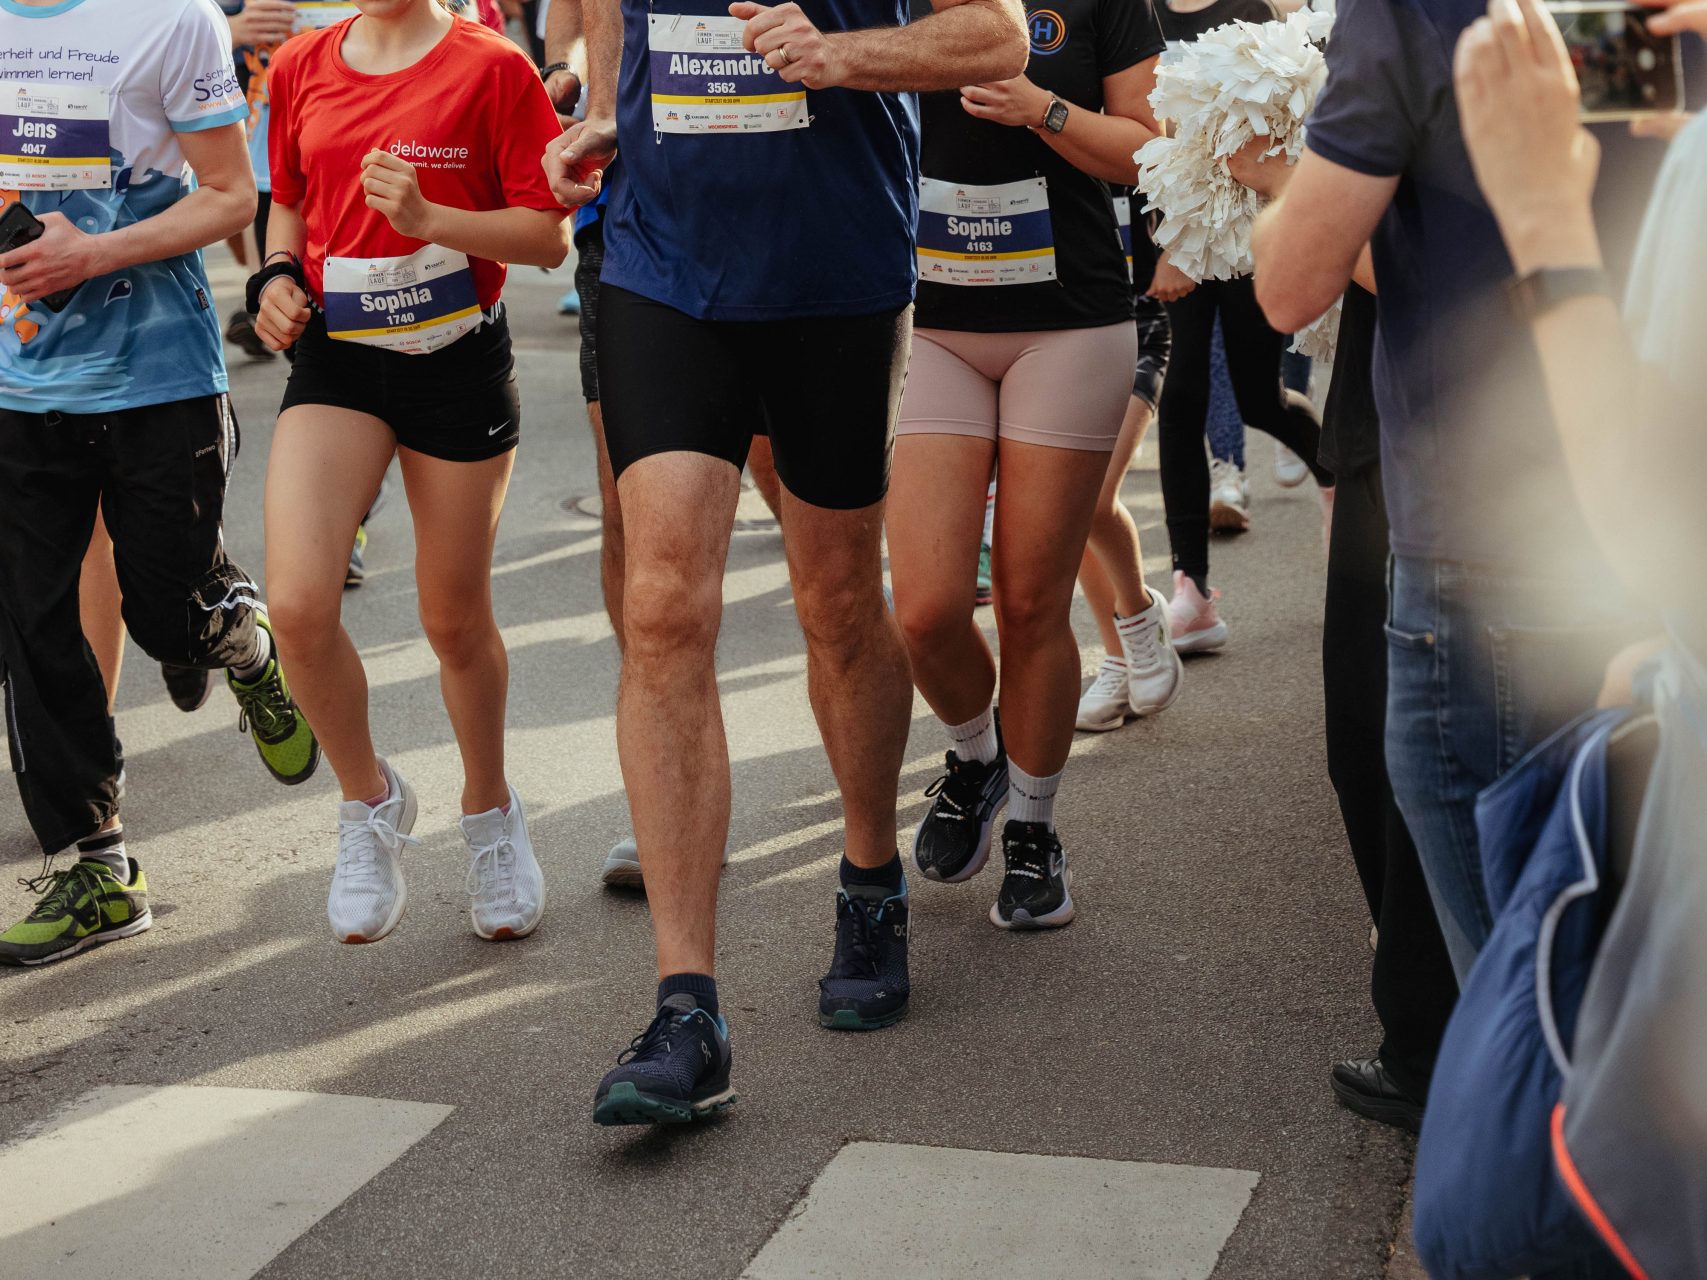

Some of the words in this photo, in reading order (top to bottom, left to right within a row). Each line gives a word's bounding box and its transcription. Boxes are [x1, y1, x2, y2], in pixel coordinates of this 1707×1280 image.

[39, 46, 62, 60] und
[68, 49, 120, 64] Freude
[48, 65, 94, 82] lernen!
[707, 82, 736, 94] 3562
[13, 118, 57, 139] Jens
[21, 143, 47, 155] 4047
[390, 139, 469, 159] delaware
[947, 216, 1012, 240] Sophie
[966, 241, 993, 252] 4163
[360, 287, 432, 313] Sophia
[386, 312, 415, 325] 1740
